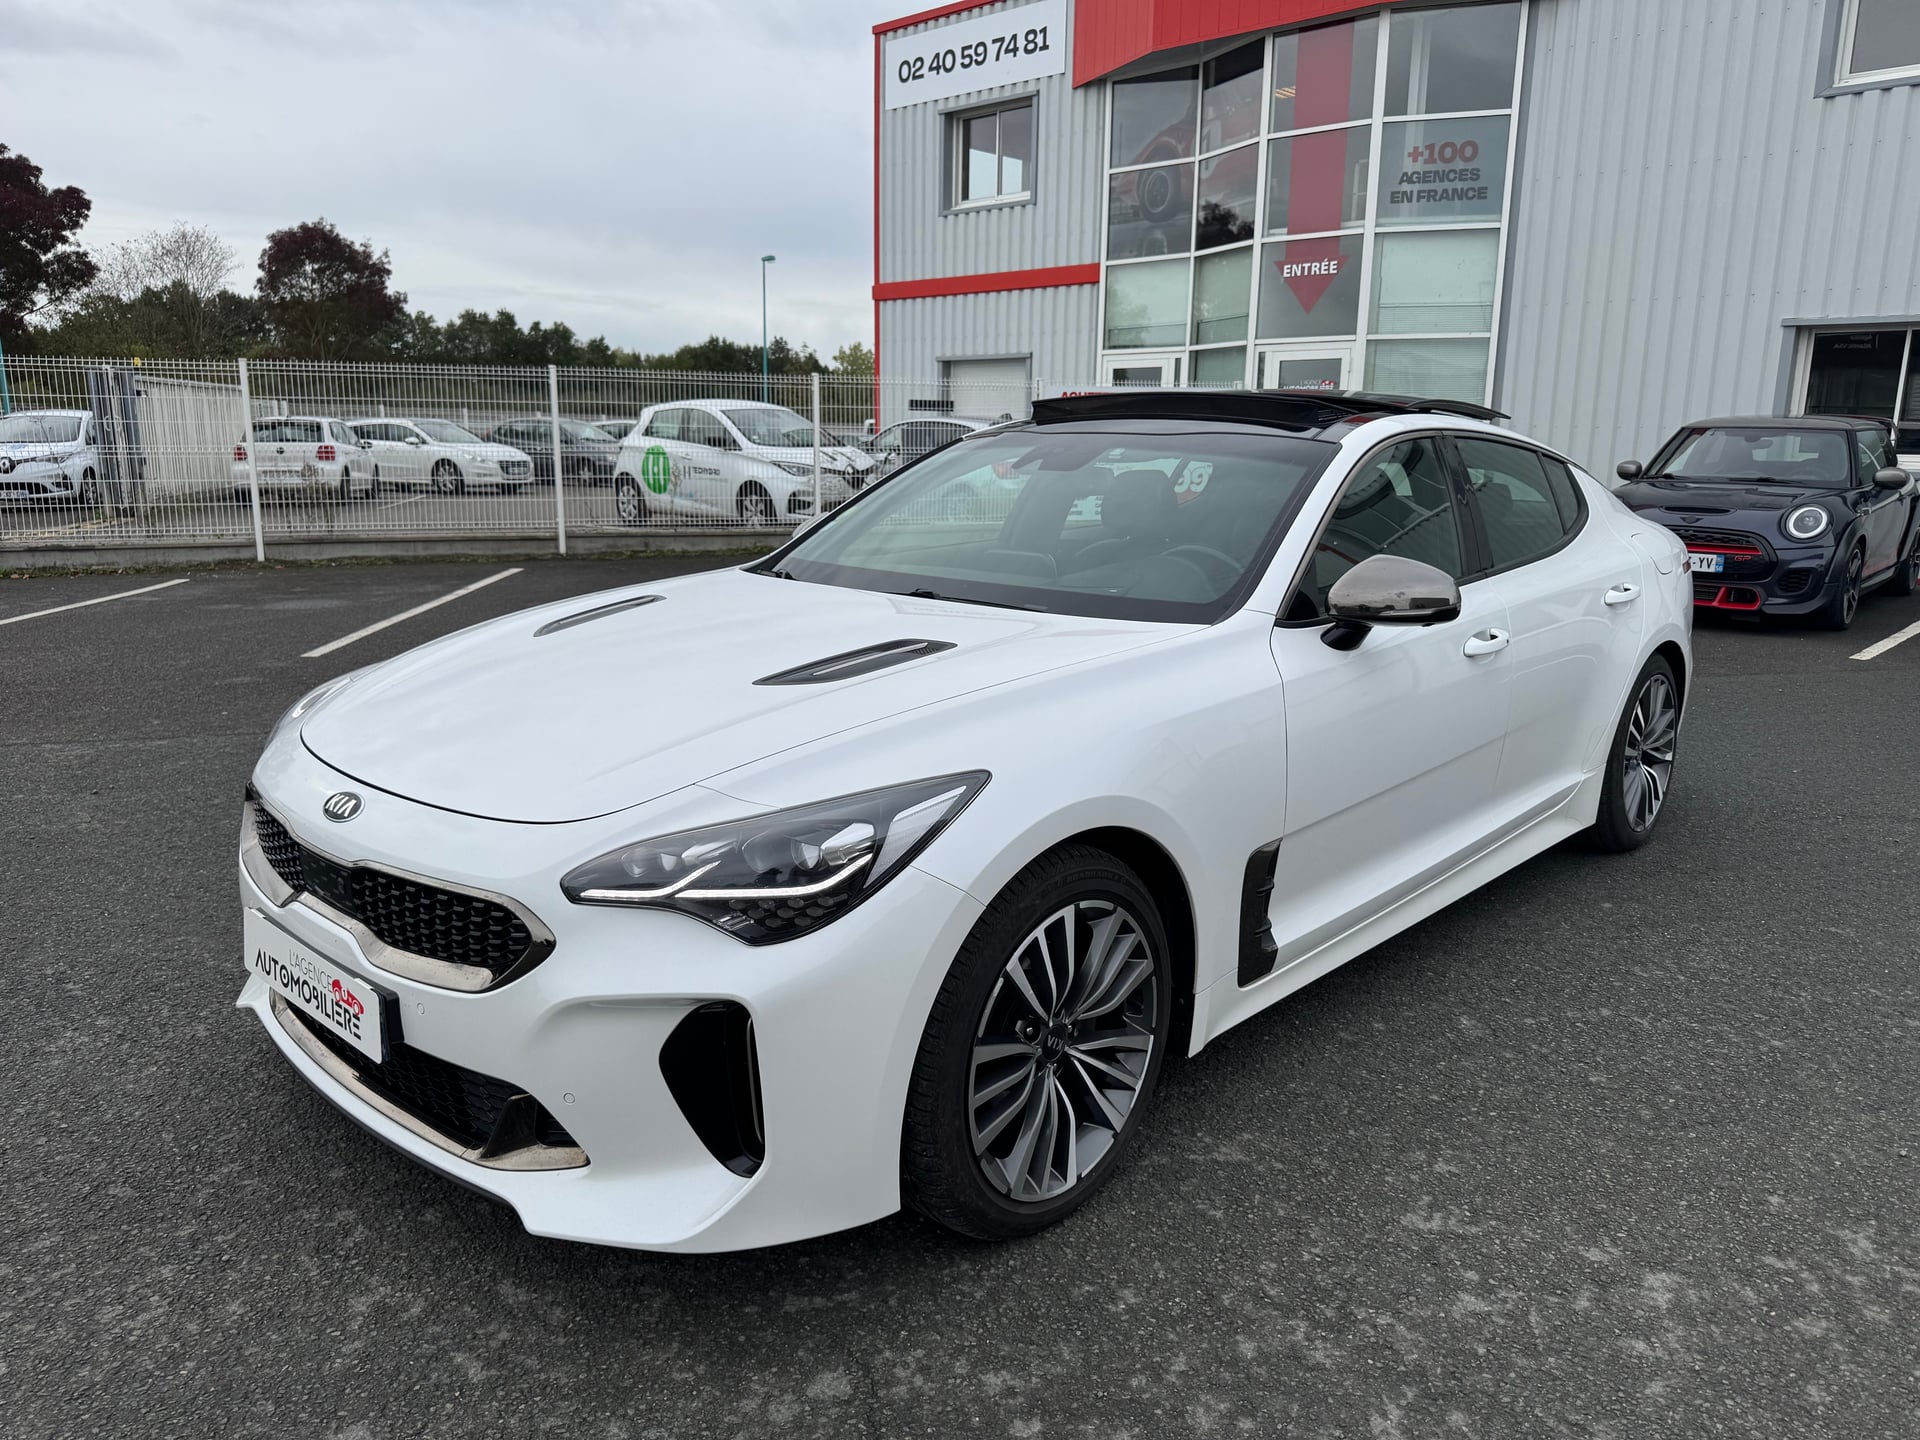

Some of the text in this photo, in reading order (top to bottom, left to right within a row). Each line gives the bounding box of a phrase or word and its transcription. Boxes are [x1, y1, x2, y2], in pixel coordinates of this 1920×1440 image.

[898, 26, 1050, 84] 02 40 59 74 81
[1407, 140, 1479, 165] +100
[1398, 168, 1481, 185] AGENCES
[1390, 186, 1489, 204] EN FRANCE
[1283, 258, 1338, 278] ENTRÉE
[325, 793, 357, 817] KIA
[289, 948, 333, 993] L'AGENCE
[1047, 1034, 1064, 1051] KIA
